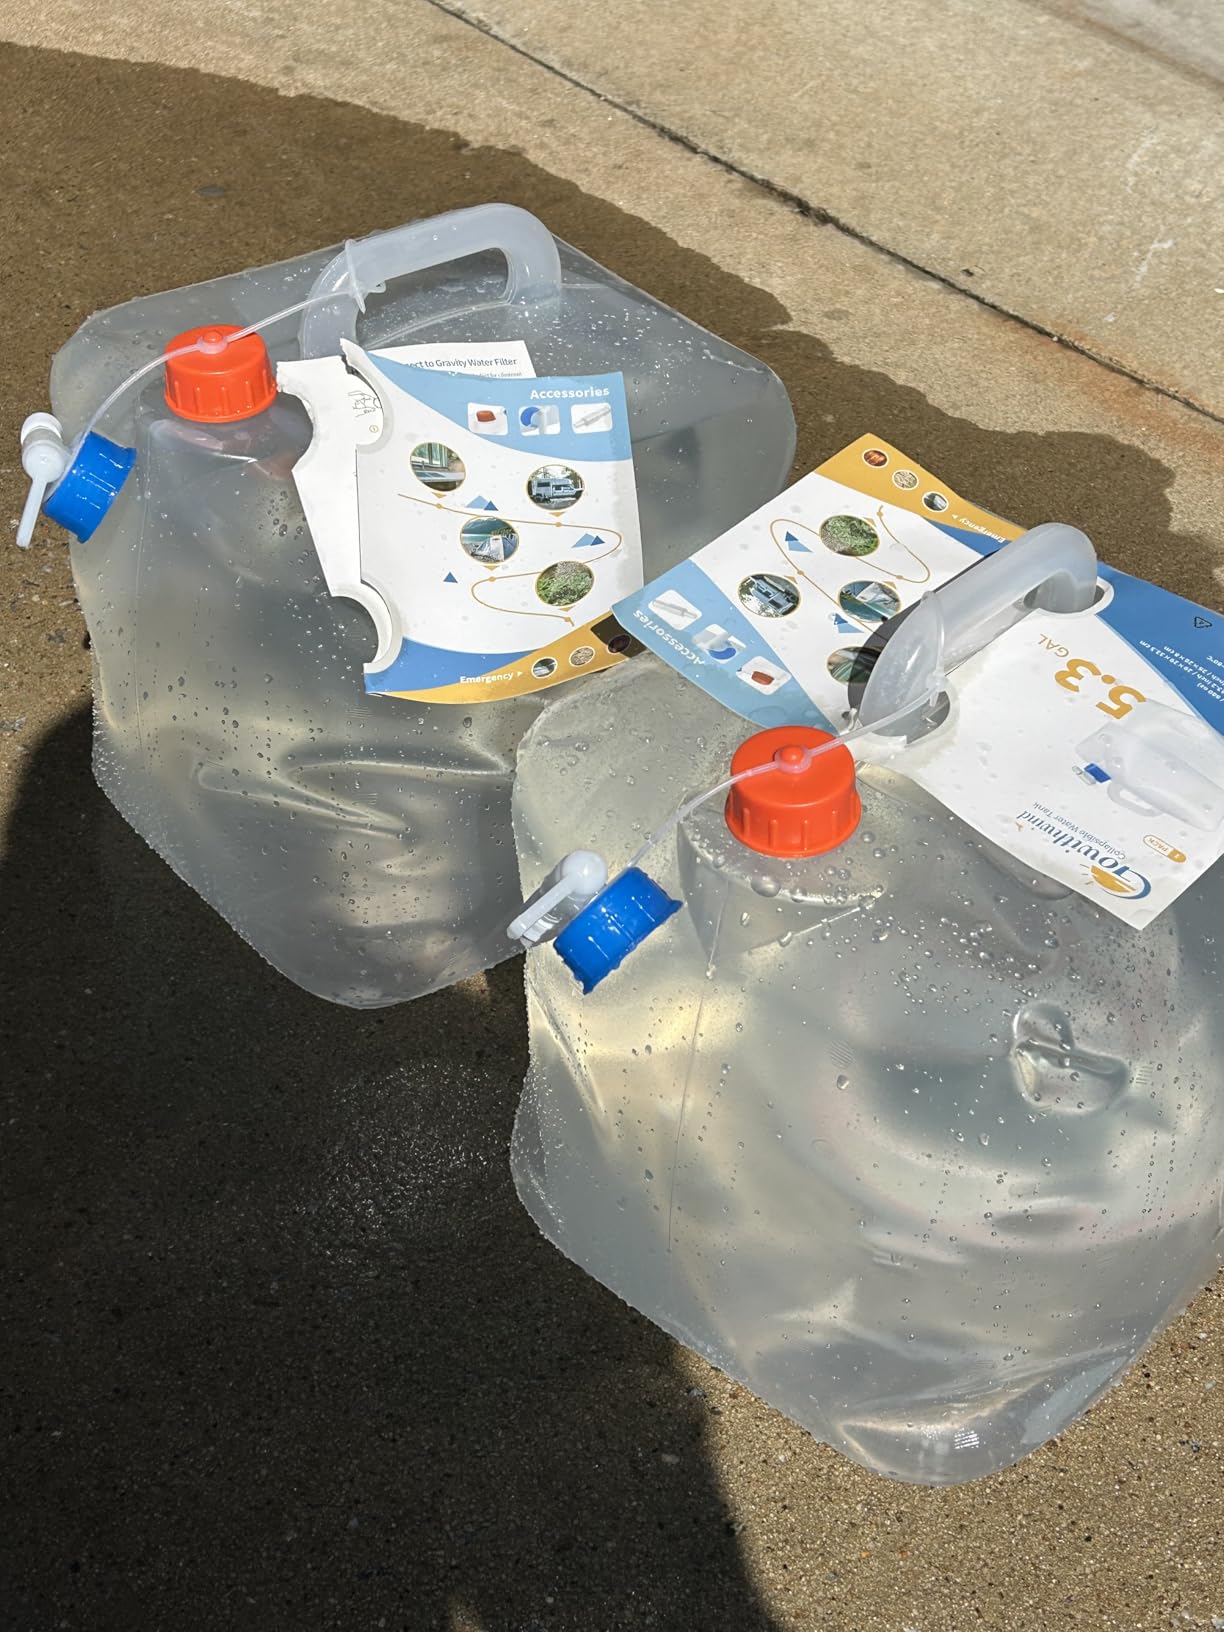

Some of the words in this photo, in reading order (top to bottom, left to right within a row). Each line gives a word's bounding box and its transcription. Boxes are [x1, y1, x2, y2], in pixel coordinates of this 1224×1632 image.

[424, 360, 434, 368] to
[435, 358, 467, 368] Gravity
[465, 358, 494, 367] Water
[494, 357, 517, 366] Filter
[529, 386, 610, 400] Accessories
[959, 517, 1007, 544] Emergency
[633, 609, 705, 665] Accessories
[1037, 633, 1070, 658] GAL
[459, 672, 514, 683] Emergency
[1054, 658, 1148, 720] 5.3
[1032, 802, 1052, 818] Tank
[1053, 814, 1079, 834] Water
[1015, 810, 1152, 900] Gowithwind
[1078, 828, 1126, 861] Collapsible
[1148, 837, 1169, 852] PACK
